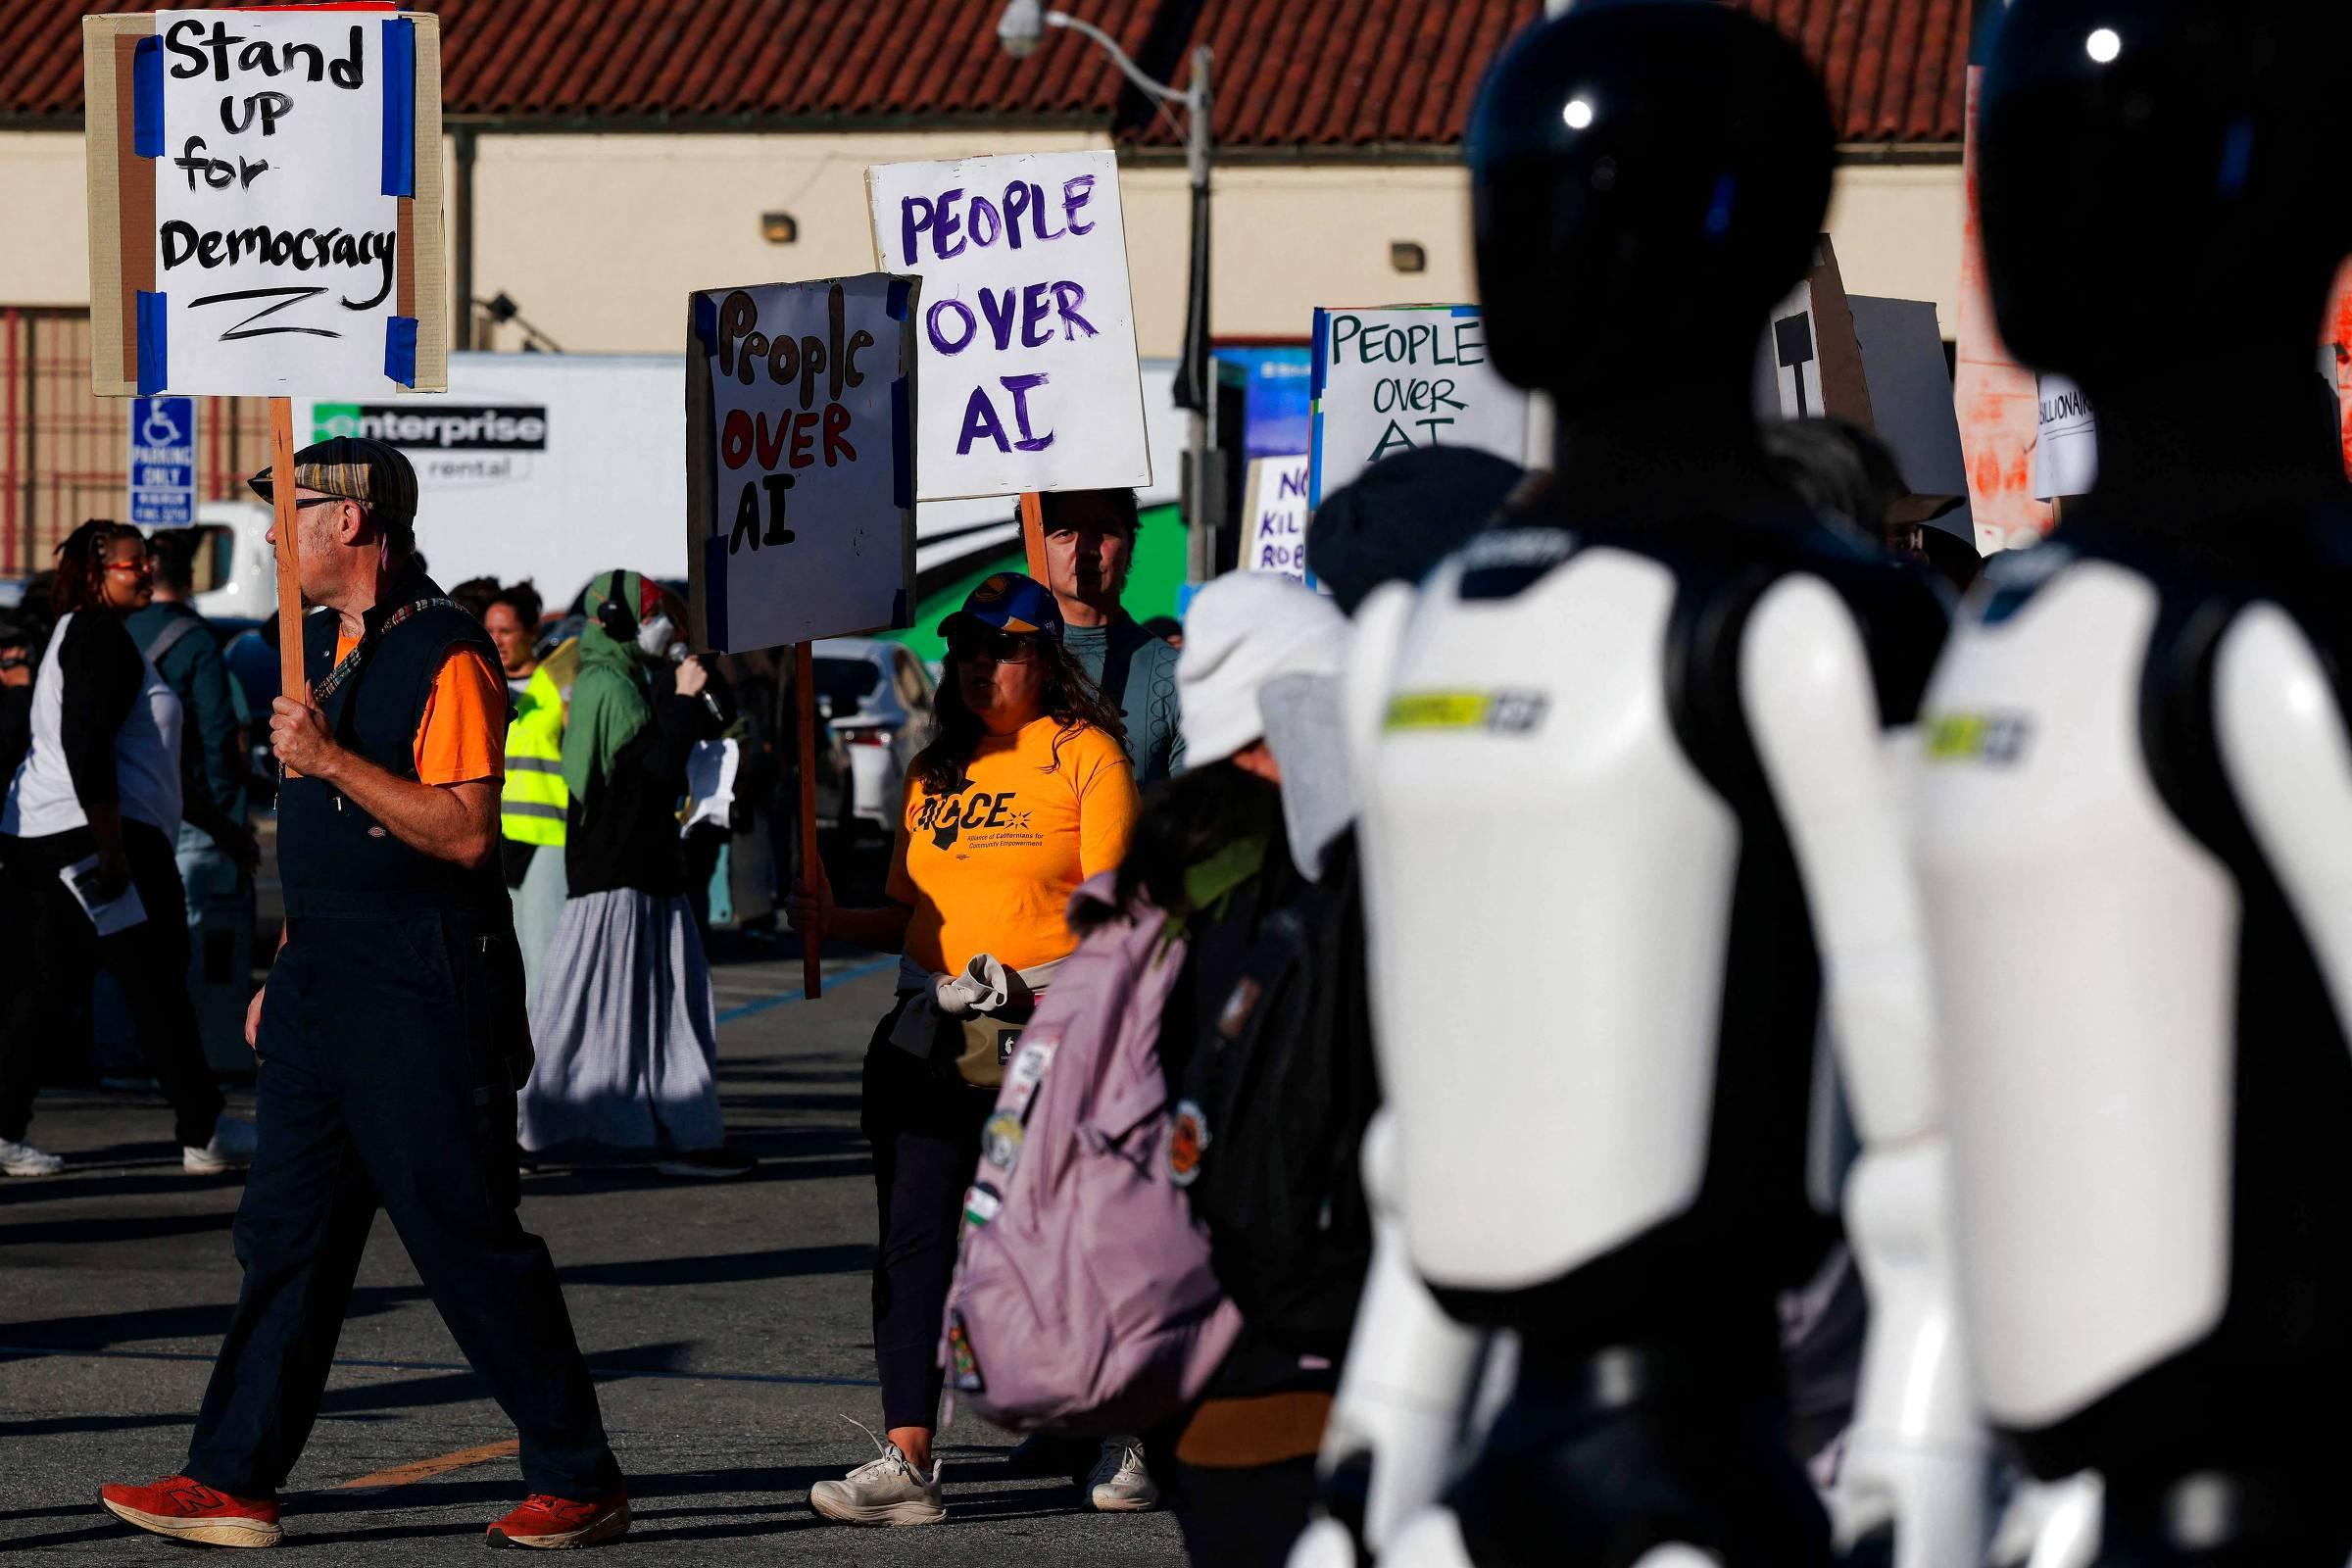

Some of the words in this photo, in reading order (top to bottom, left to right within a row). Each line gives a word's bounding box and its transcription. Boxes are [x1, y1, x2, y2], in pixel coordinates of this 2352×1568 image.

[165, 20, 364, 89] Stand
[174, 135, 269, 192] for
[902, 174, 1096, 267] PEOPLE
[161, 220, 396, 311] Democracy
[718, 284, 875, 411] People
[926, 281, 1100, 356] OVER
[1333, 315, 1485, 367] PEOPLE
[326, 411, 545, 447] enterprise
[721, 403, 858, 470] OVER
[956, 372, 1055, 456] AI
[429, 461, 512, 478] rental
[729, 472, 797, 556] AI
[1259, 511, 1300, 539] KIL
[1261, 544, 1304, 568] ROB
